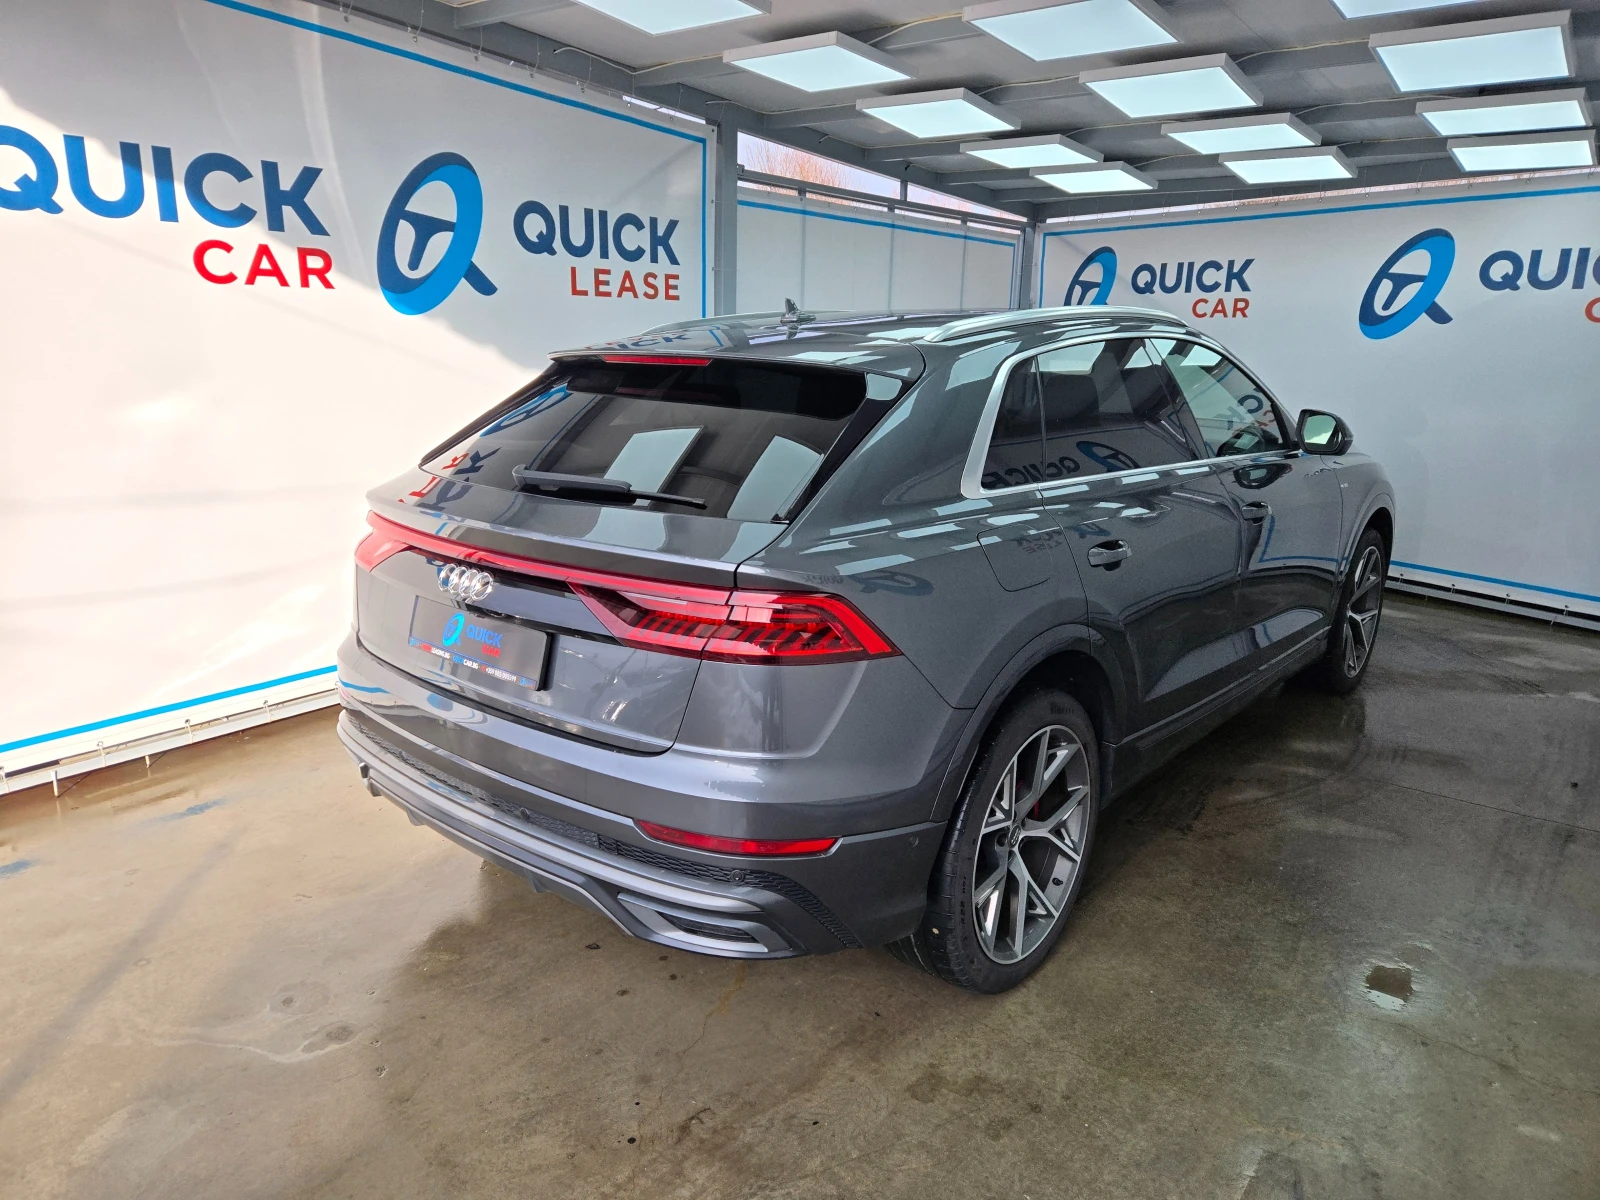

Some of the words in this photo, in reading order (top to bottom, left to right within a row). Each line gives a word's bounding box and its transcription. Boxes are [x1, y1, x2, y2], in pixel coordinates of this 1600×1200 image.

[0, 125, 331, 237] QUICK
[512, 199, 681, 266] QUICK
[192, 239, 336, 290] CAR
[1131, 258, 1256, 295] QUICK
[570, 265, 681, 301] LEASE
[1191, 297, 1250, 319] CAR
[466, 625, 502, 648] QUICK
[481, 645, 501, 658] CAR
